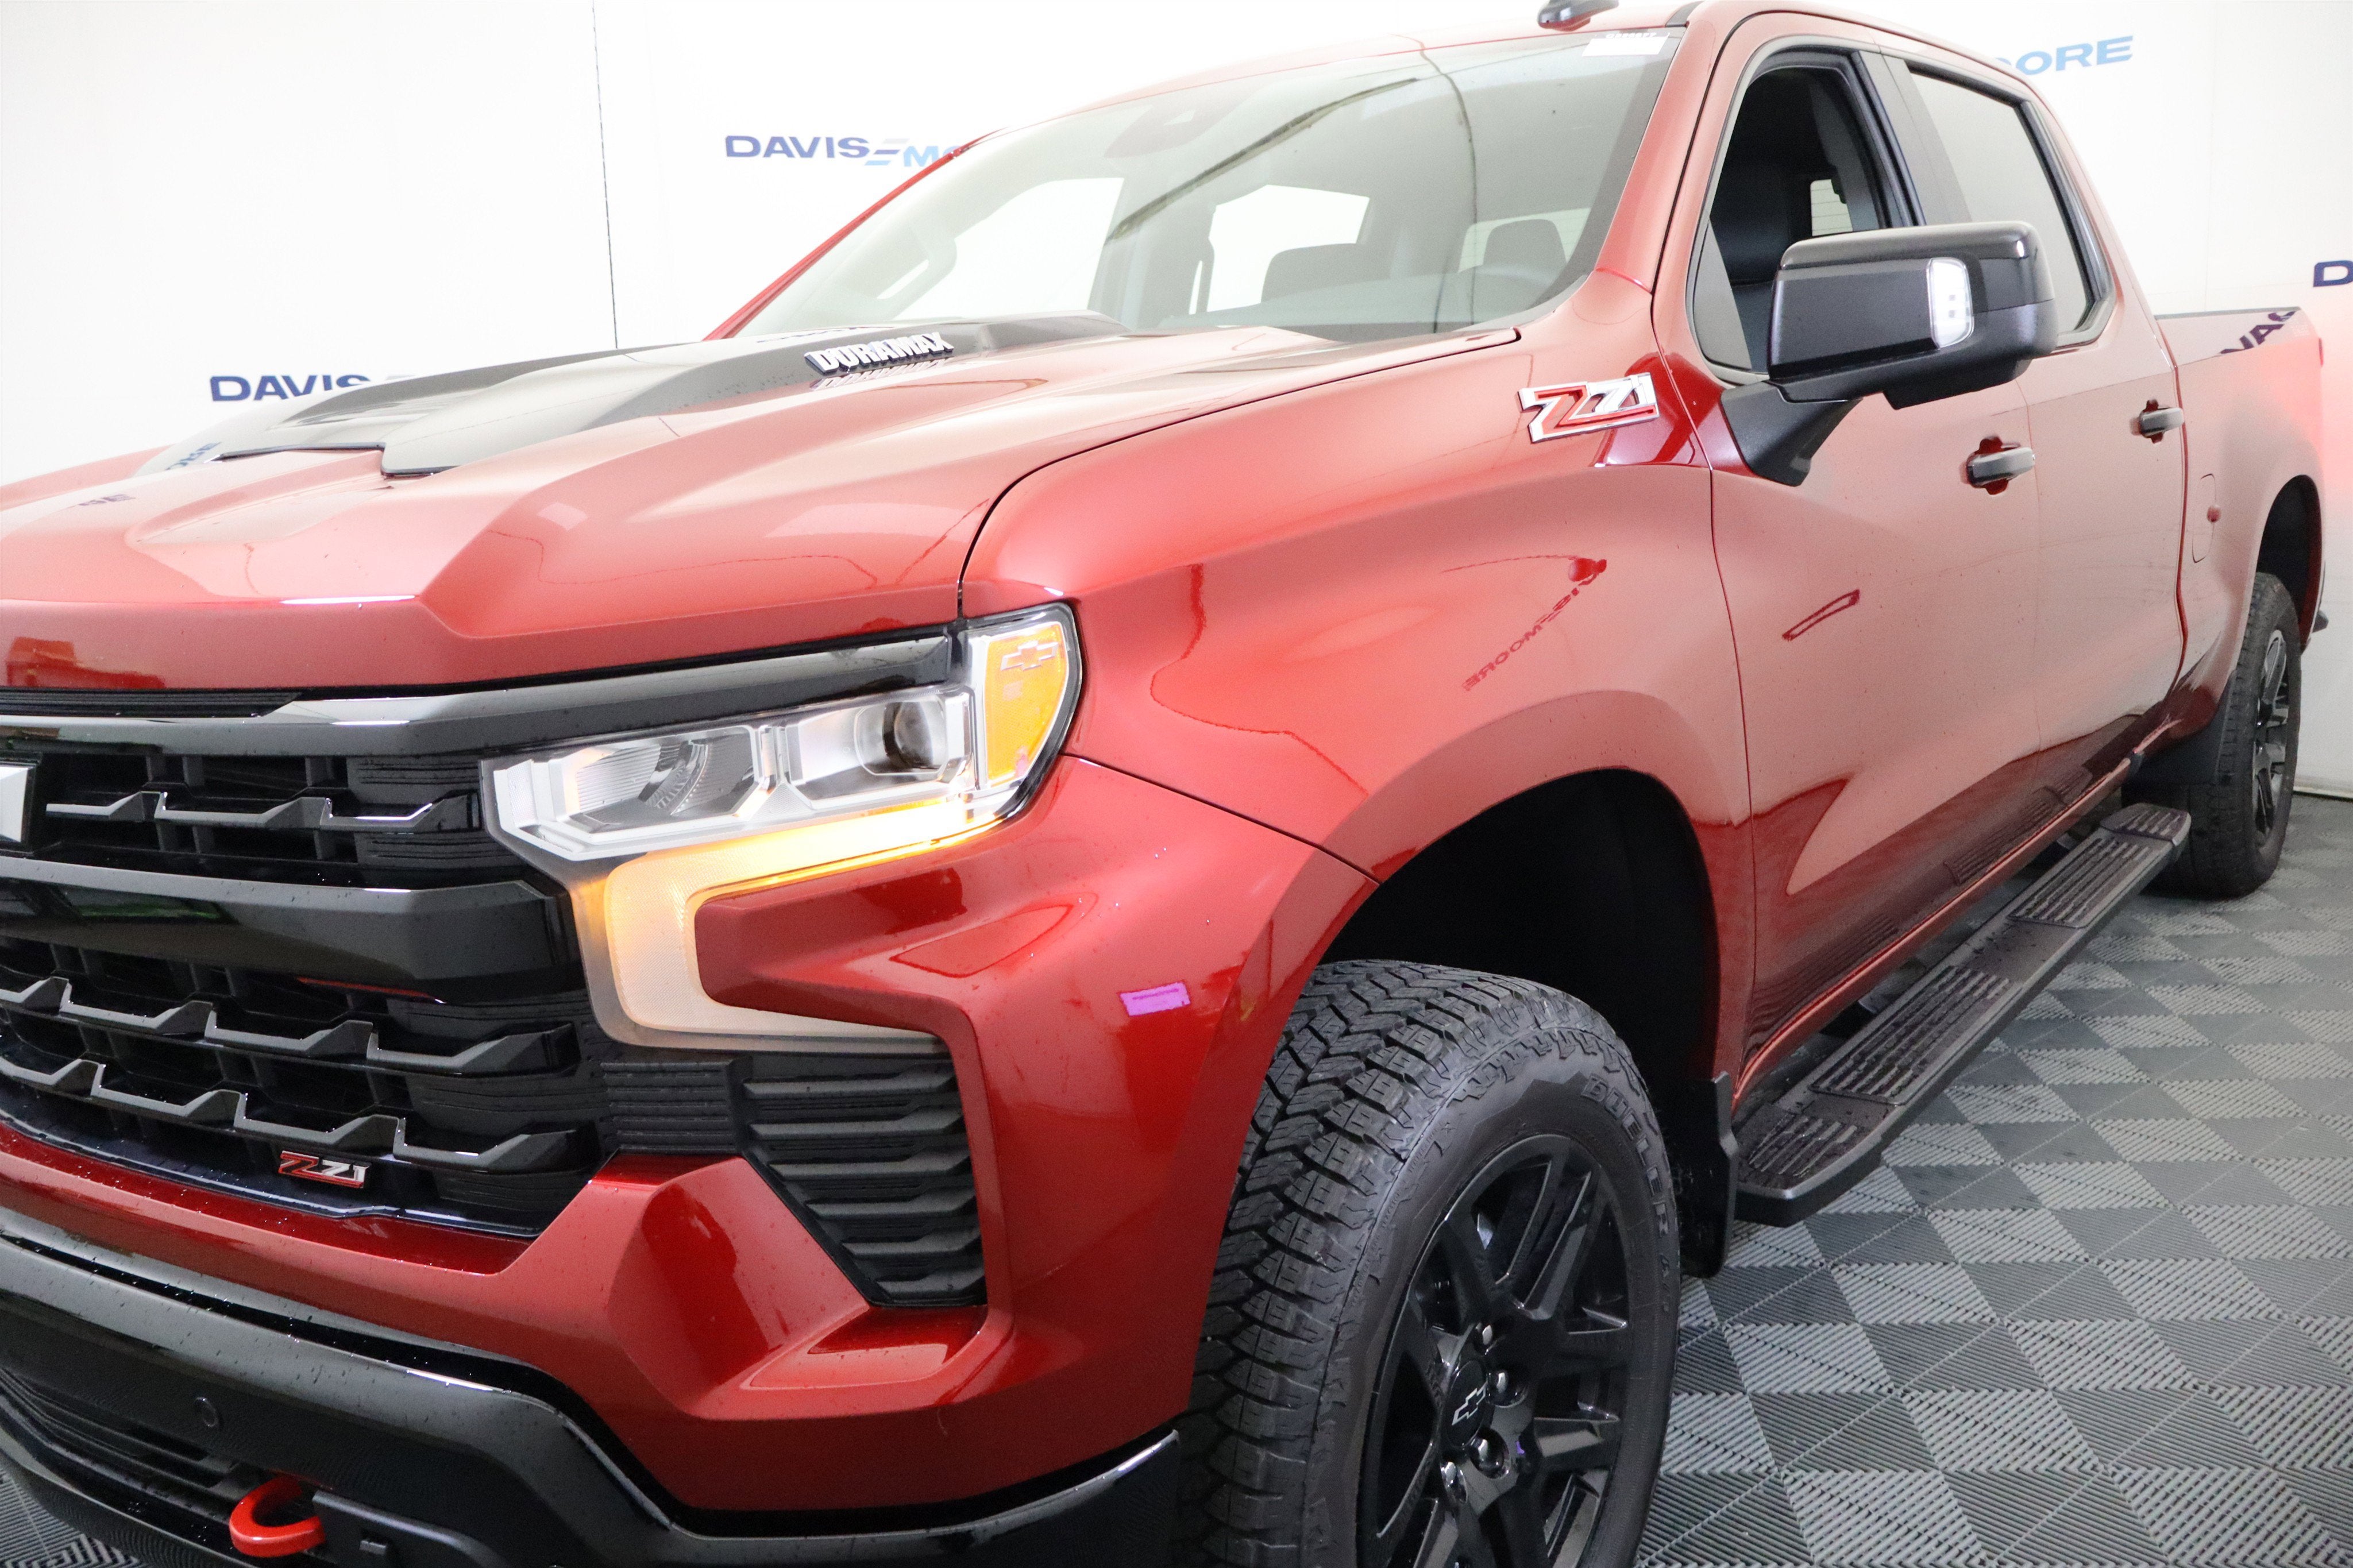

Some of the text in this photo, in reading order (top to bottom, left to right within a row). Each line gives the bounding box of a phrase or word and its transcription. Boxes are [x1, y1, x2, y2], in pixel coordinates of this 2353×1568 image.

[1996, 36, 2133, 76] ORE
[725, 136, 870, 159] DAVIS
[804, 331, 955, 374] DURAMAX
[1517, 372, 1660, 443] Z71
[277, 1150, 371, 1189] Z71
